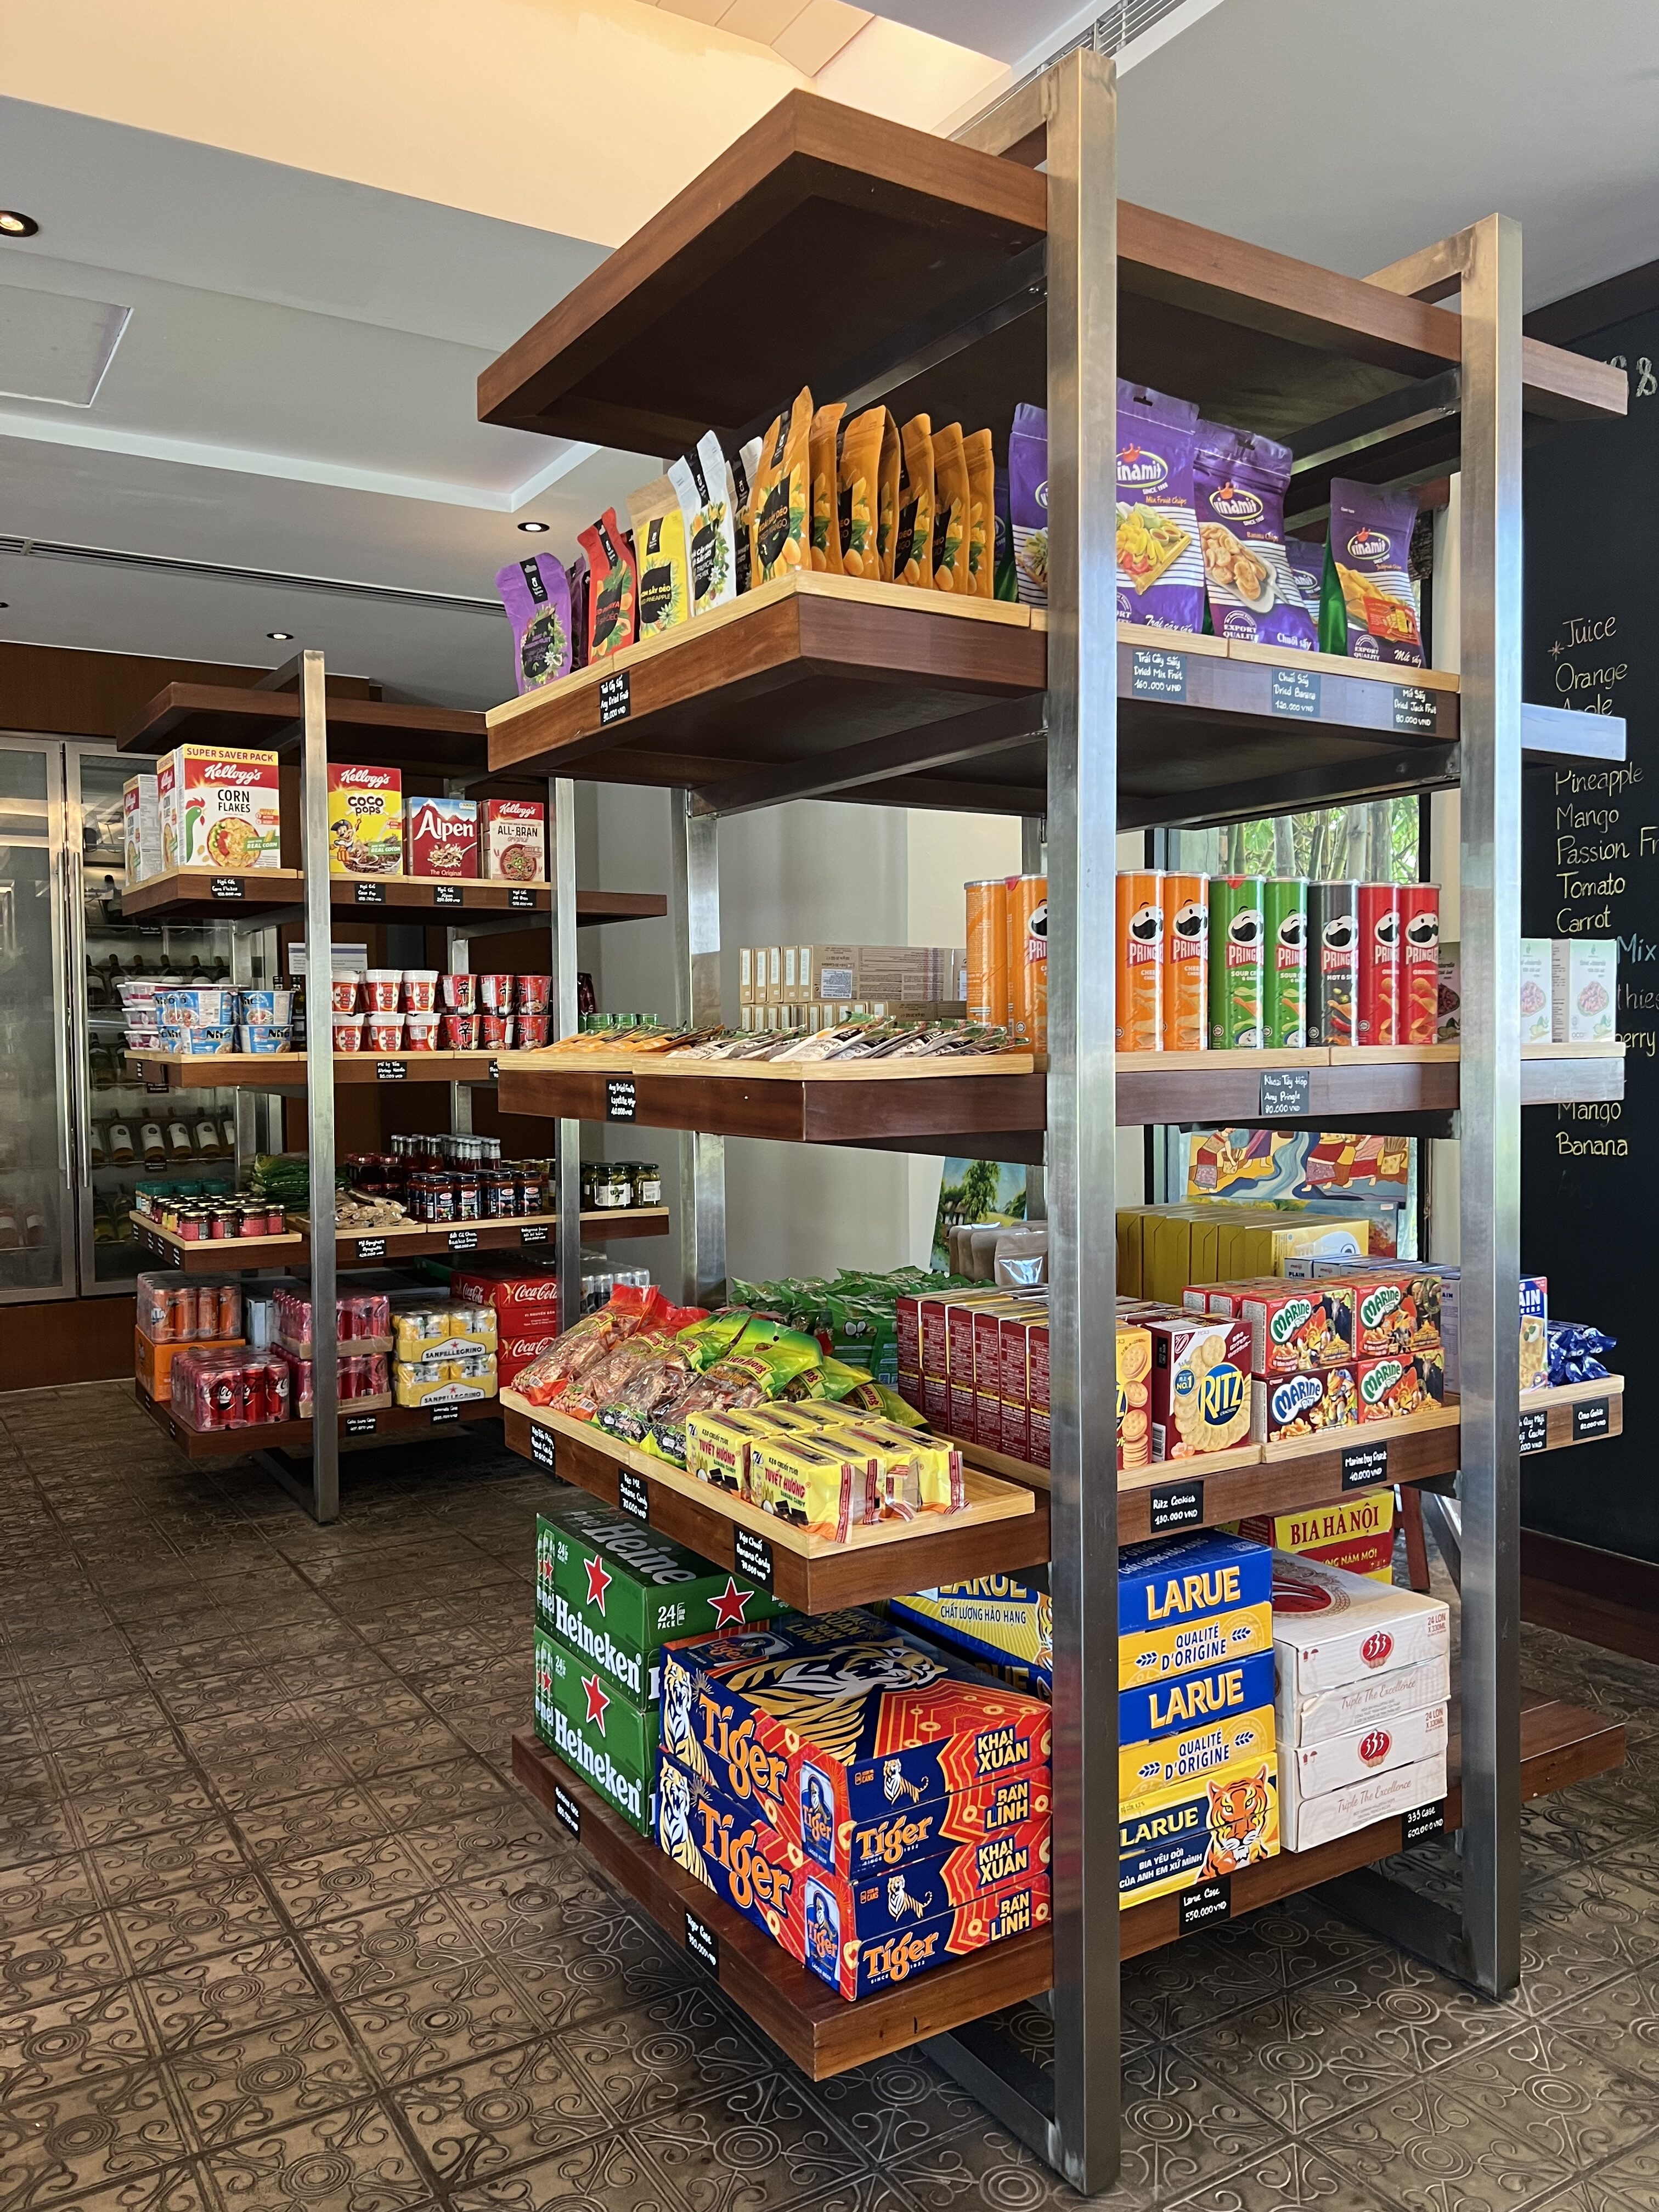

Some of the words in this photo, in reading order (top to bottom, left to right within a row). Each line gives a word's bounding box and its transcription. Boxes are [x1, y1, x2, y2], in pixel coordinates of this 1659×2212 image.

[1118, 461, 1162, 481] inamit
[1223, 625, 1256, 634] EXPORT
[1562, 617, 1617, 647] Juice
[1133, 665, 1151, 676] Dried
[1153, 669, 1166, 679] Mix
[1556, 663, 1628, 692] Orange
[1166, 684, 1182, 692] VND
[1274, 684, 1292, 696] Dried
[1295, 687, 1316, 700] Banana
[1394, 698, 1408, 710] Dried
[1418, 718, 1431, 726] VND
[187, 747, 217, 758] SUPER
[218, 749, 248, 760] SAVER
[250, 752, 274, 762] PACK
[204, 762, 263, 785] Kellogg's
[341, 768, 391, 788] Kellogg's
[1556, 761, 1644, 797] Pineapple
[217, 789, 250, 803] CORN
[218, 802, 251, 813] FLAKES
[354, 806, 381, 816] pops
[499, 802, 537, 818] Kellogg's
[1557, 803, 1619, 834] Mango
[414, 809, 473, 842] Alpen
[498, 825, 538, 837] ALL-BRAN
[1558, 835, 1630, 865] Passion
[1556, 871, 1626, 899] Tomato
[1556, 904, 1612, 933] Carrot
[1616, 933, 1658, 965] Mix
[1264, 1075, 1282, 1086] Khoai
[1264, 1092, 1277, 1104] Any
[1280, 1091, 1300, 1104] Pringle
[1556, 1132, 1629, 1156] Banana
[426, 1347, 482, 1359] SANPELLEGRINO
[1200, 1371, 1242, 1425] RITZ
[699, 1438, 715, 1457] TUYẾT
[765, 1468, 782, 1488] TUYẾT
[1370, 1467, 1383, 1476] VND
[1153, 1499, 1169, 1510] Ritz
[1183, 1509, 1198, 1519] VND
[1290, 1522, 1321, 1546] BIA
[1322, 1507, 1347, 1539] HÀ
[1350, 1502, 1380, 1533] NỘI
[736, 1543, 755, 1561] Banana
[754, 1553, 770, 1573] Candy
[1341, 1551, 1360, 1565] NĂM
[1361, 1548, 1378, 1562] MỚI
[1146, 1565, 1241, 1621] LARUE
[657, 1604, 676, 1622] 24
[657, 1620, 676, 1630] PACK
[940, 1602, 958, 1618] CHẤT
[959, 1607, 983, 1623] LƯỢNG
[984, 1606, 1000, 1622] HẢO
[1003, 1610, 1026, 1627] HẠNG
[1427, 1616, 1435, 1626] 24
[1435, 1613, 1446, 1623] LON
[555, 1592, 641, 1695] Heineken
[1176, 1622, 1220, 1649] QUALITÉ
[1161, 1639, 1227, 1671] D'ORIGINE
[1148, 1668, 1244, 1730] LARUE
[1341, 1692, 1362, 1710] Triple
[1364, 1688, 1379, 1703] The
[1379, 1679, 1418, 1699] Excellence
[1425, 1712, 1432, 1722] 24
[1432, 1707, 1443, 1718] LON
[699, 1692, 791, 1802] Tiger
[977, 1730, 1014, 1756] KHAI
[1178, 1728, 1222, 1757] QUALITÉ
[554, 1706, 642, 1820] Heineken
[978, 1743, 1029, 1774] XUÂN
[1165, 1744, 1230, 1781] D'ORIGINE
[997, 1782, 1029, 1805] BẢN
[1338, 1794, 1359, 1814] Triple
[1360, 1790, 1374, 1805] The
[1375, 1780, 1412, 1799] Excellence
[803, 1804, 832, 1842] Tiger
[986, 1794, 1029, 1830] LĨNH
[1120, 1806, 1199, 1847] LARUE
[855, 1815, 934, 1865] Tiger
[978, 1837, 1014, 1865] KHAI
[697, 1799, 792, 1916] Tiger
[862, 1857, 882, 1866] SINCE
[979, 1851, 1029, 1886] XUÂN
[1138, 1856, 1153, 1870] BIA
[1153, 1852, 1169, 1865] YÊU
[1170, 1847, 1184, 1861] ĐỜI
[1119, 1875, 1136, 1889] CỦA
[1137, 1868, 1154, 1883] ANH
[1155, 1864, 1169, 1877] EM
[1169, 1858, 1181, 1873] XỨ
[1182, 1852, 1203, 1867] MÌNH
[1000, 1889, 1030, 1912] BẢN
[1183, 1894, 1201, 1906] Larue
[1204, 1887, 1220, 1899] Case
[991, 1901, 1031, 1942] LĨNH
[1185, 1905, 1214, 1922] 550.000
[1213, 1900, 1227, 1911] VND
[807, 1919, 838, 1958] Tiger
[862, 1929, 940, 1982] Tiger
[870, 1974, 889, 1984] SINCE
